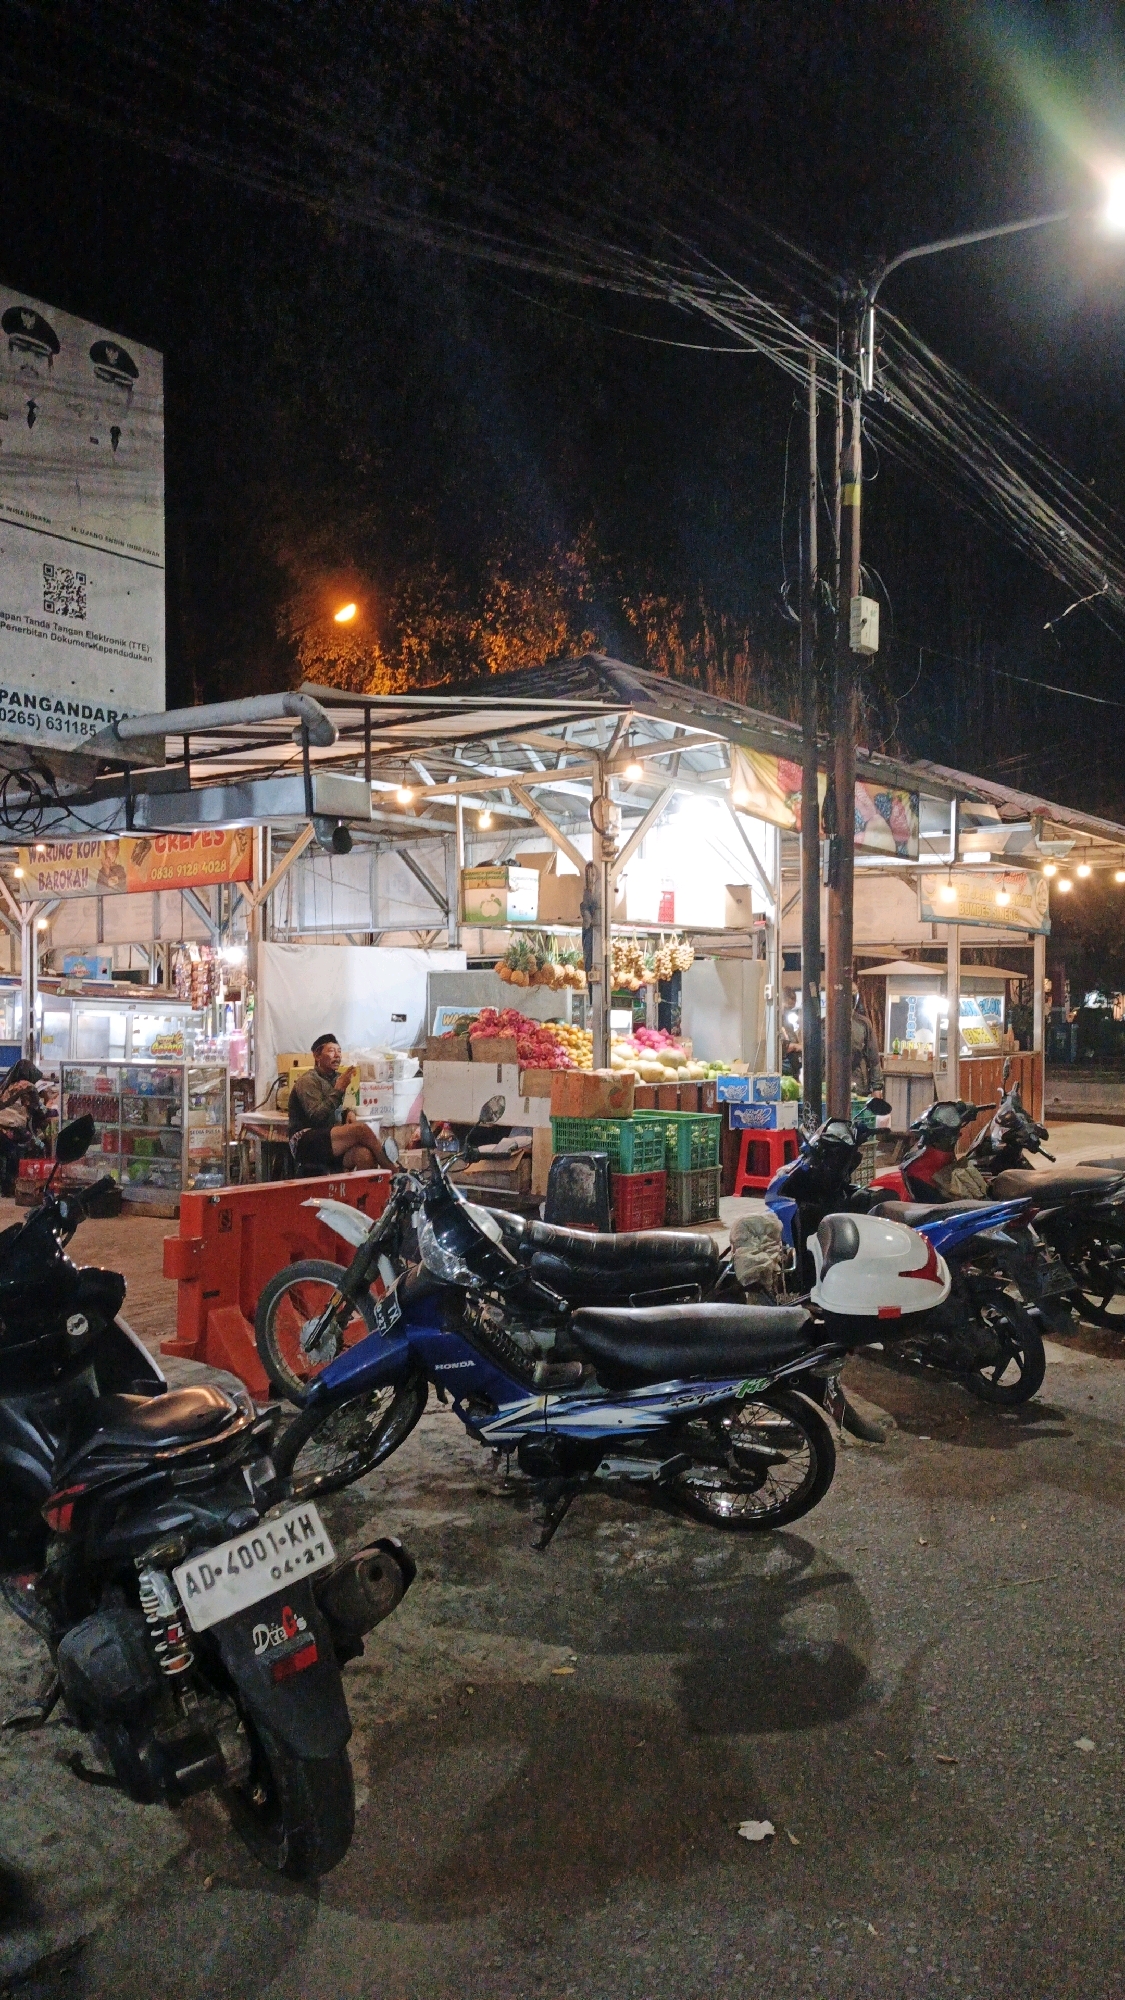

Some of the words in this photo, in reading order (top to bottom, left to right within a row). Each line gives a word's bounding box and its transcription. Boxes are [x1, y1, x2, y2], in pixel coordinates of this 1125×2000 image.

[0, 620, 48, 640] Penerbitan
[23, 615, 51, 630] Tanda
[53, 622, 84, 637] Tangan
[86, 630, 127, 647] Elektronik
[128, 640, 150, 654] (TTE)
[45, 716, 97, 738] 631185
[76, 840, 102, 860] KOPI
[154, 829, 226, 854] CREPES
[38, 867, 89, 891] BAROKAH
[151, 865, 174, 881] 0838
[176, 861, 199, 878] 9128
[201, 859, 227, 874] 4028
[958, 901, 991, 918] BUMDES
[434, 1360, 476, 1371] HONDA
